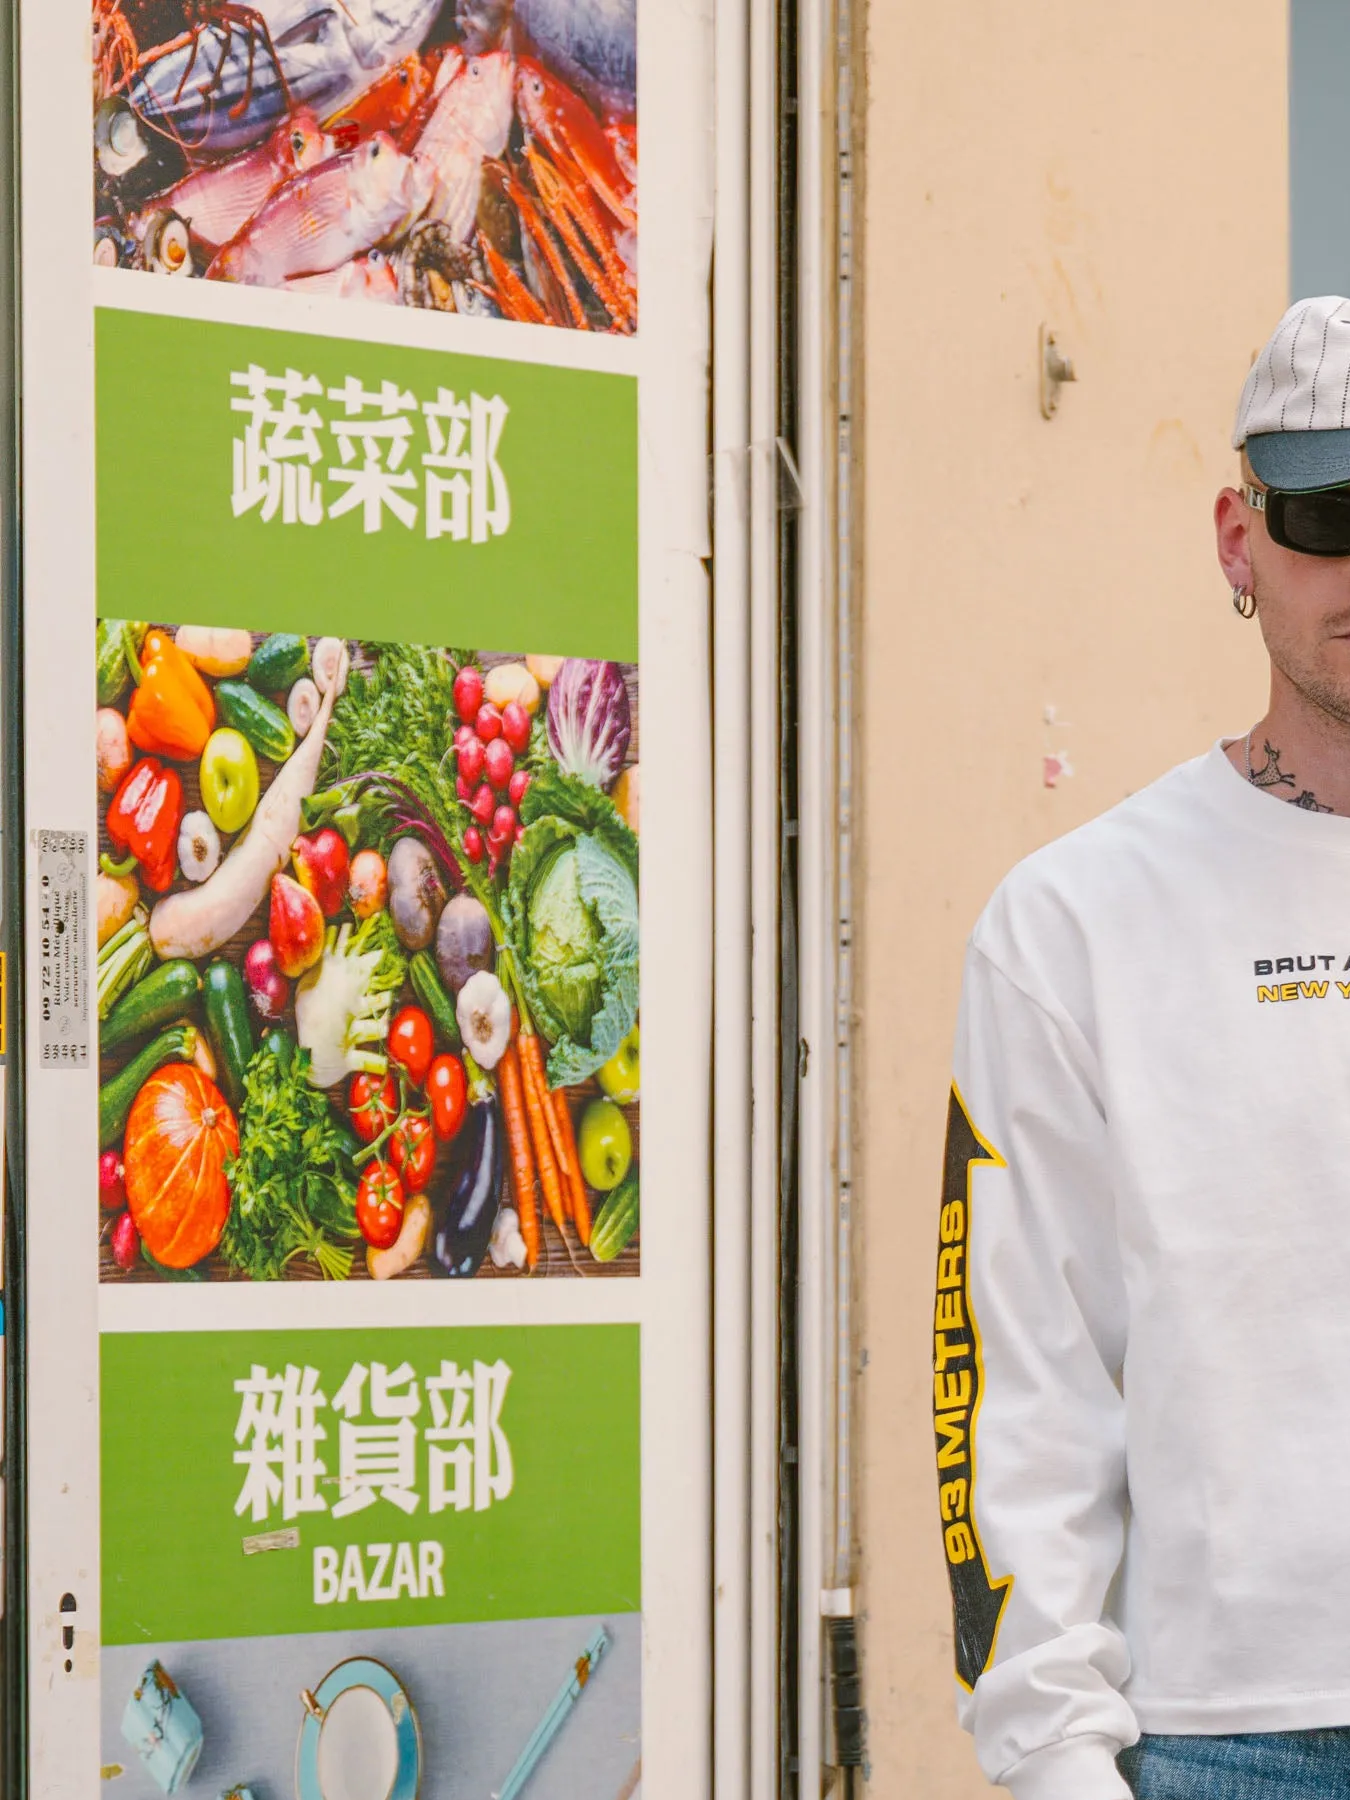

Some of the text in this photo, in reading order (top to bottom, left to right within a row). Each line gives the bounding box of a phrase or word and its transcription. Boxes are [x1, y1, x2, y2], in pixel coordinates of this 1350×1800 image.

[230, 362, 512, 544] 蔬菜部
[41, 908, 51, 931] 54
[41, 937, 51, 958] 10
[53, 891, 63, 1006] Rideau Métllique
[41, 965, 51, 990] 72
[1254, 954, 1336, 976] BRUT
[1256, 980, 1330, 1003] NEW
[41, 997, 51, 1021] 09
[933, 1199, 976, 1565] 93 METERS
[233, 1358, 515, 1522] 雜貨部
[313, 1540, 445, 1604] BAZAR
